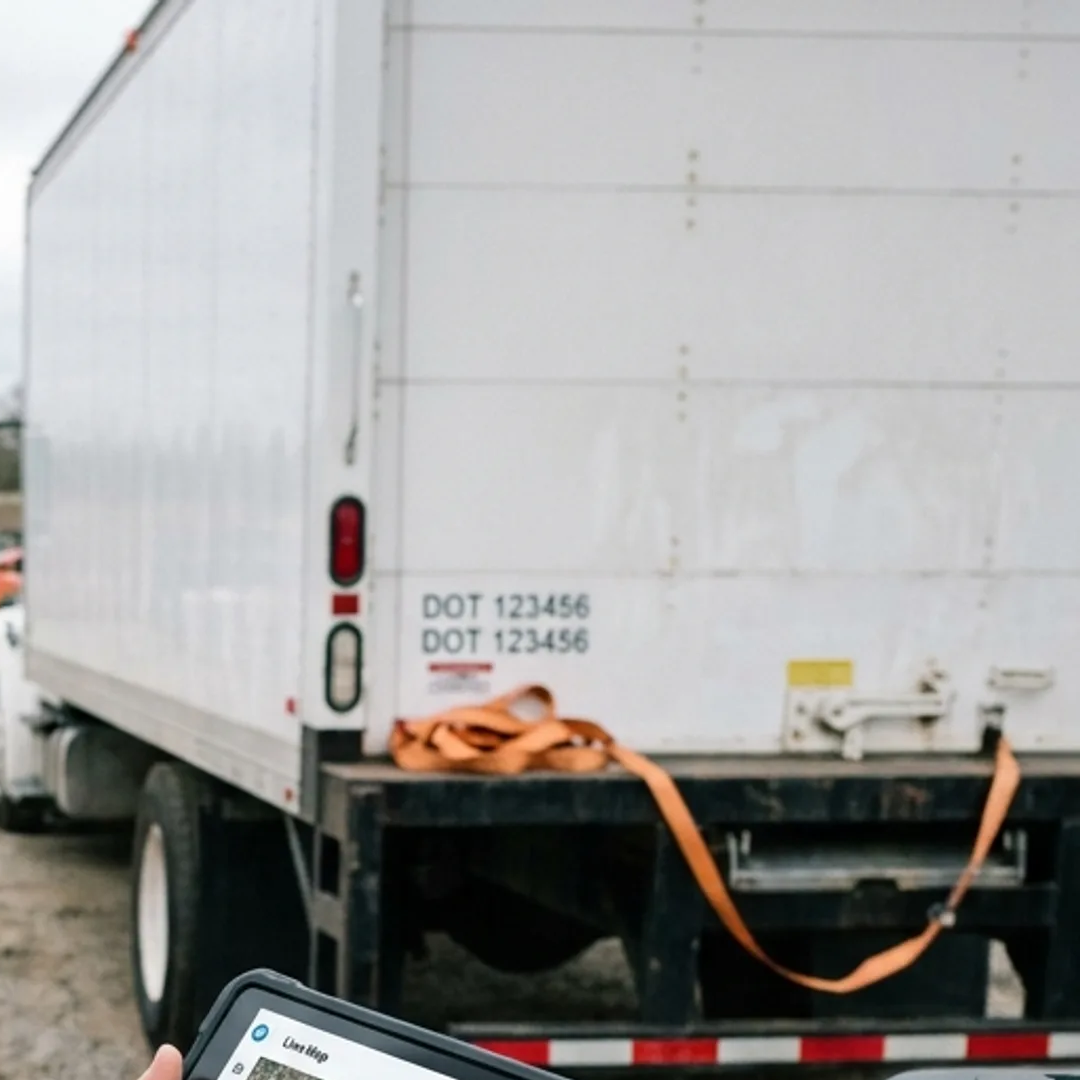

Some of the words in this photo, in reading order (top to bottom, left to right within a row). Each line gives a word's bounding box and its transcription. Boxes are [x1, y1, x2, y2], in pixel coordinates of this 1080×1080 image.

[422, 593, 482, 619] DOT
[494, 594, 590, 619] 123456
[421, 629, 481, 653] DOT
[493, 629, 589, 653] 123456
